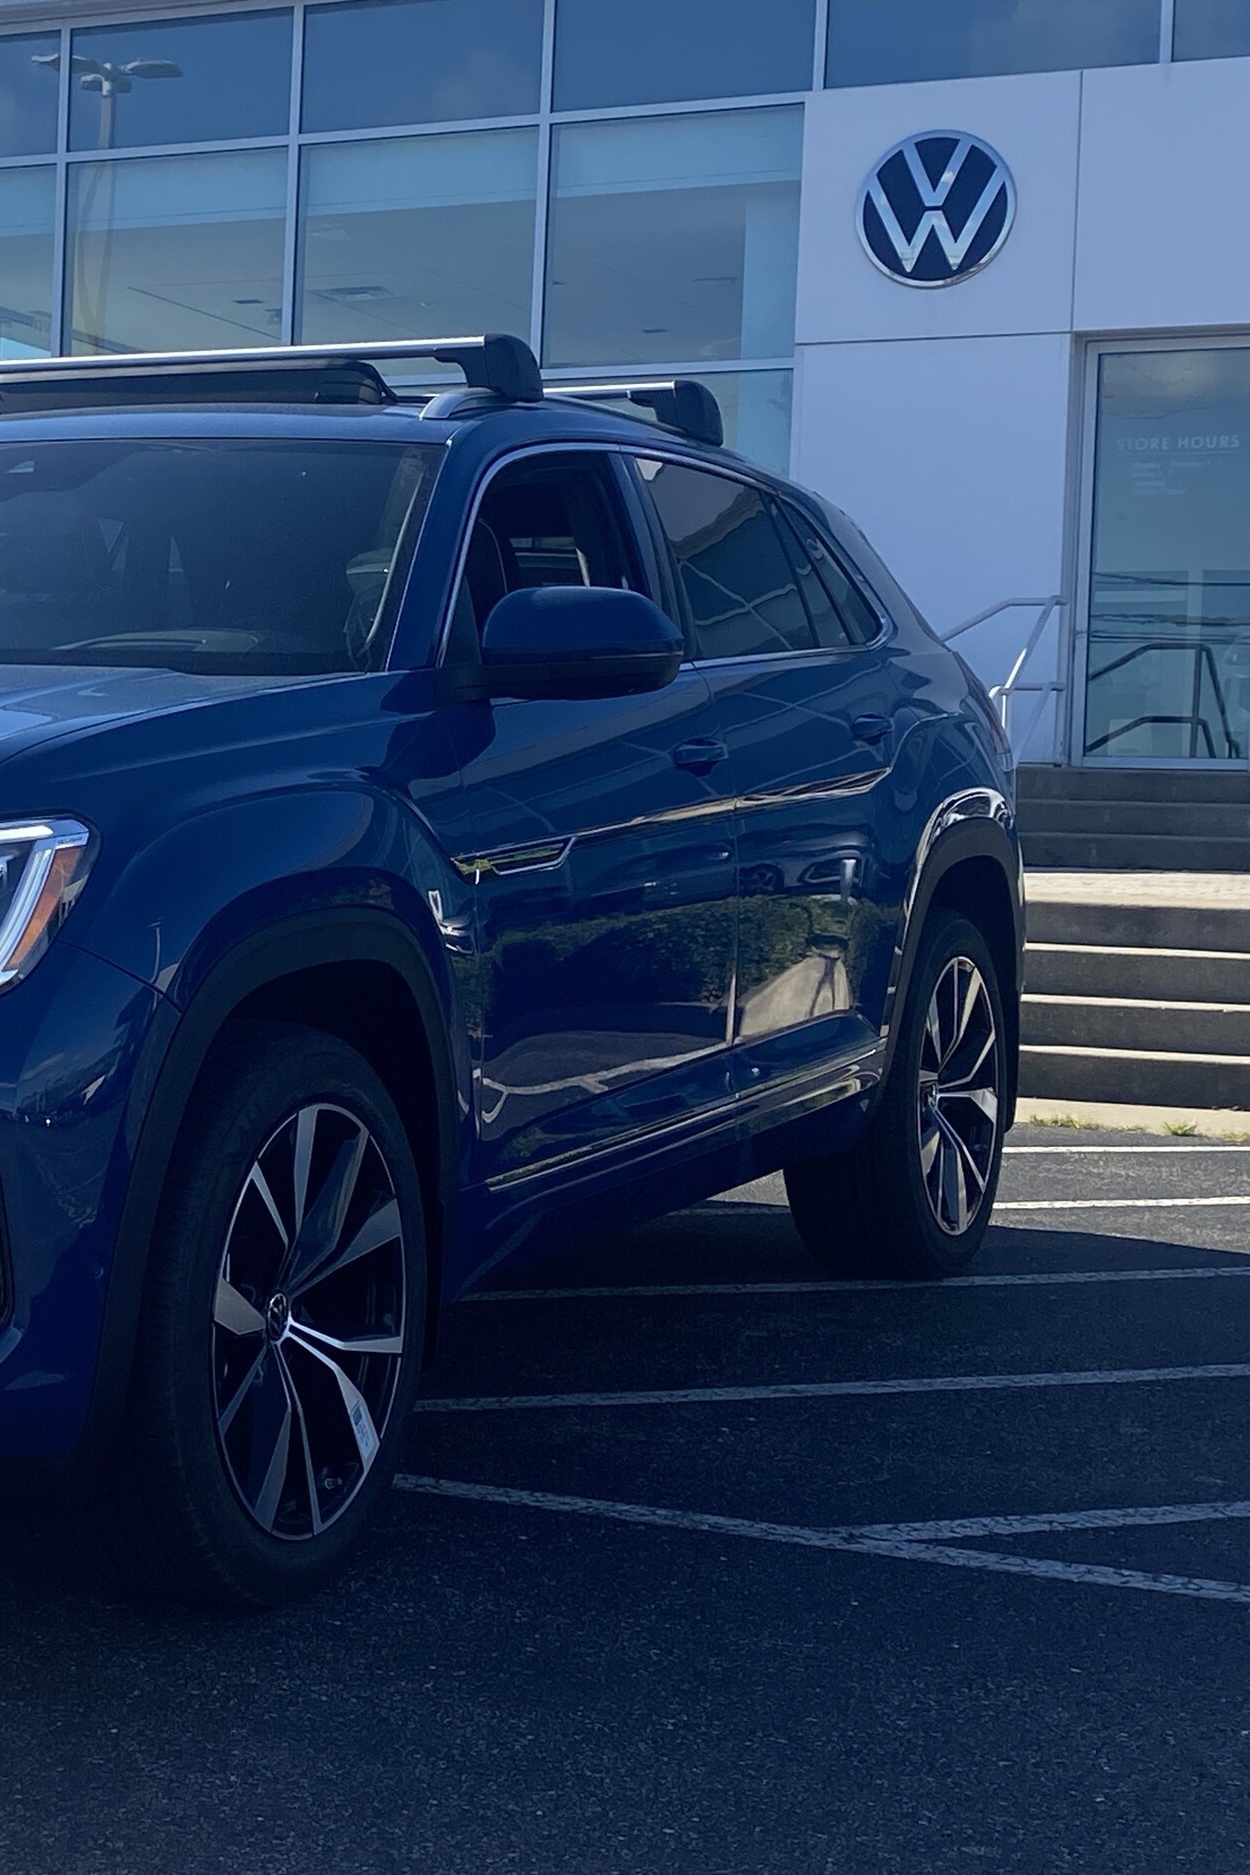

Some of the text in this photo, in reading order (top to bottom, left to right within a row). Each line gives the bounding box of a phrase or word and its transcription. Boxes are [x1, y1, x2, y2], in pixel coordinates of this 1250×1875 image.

[861, 134, 1010, 280] VW
[1116, 435, 1241, 451] STORE HOURS
